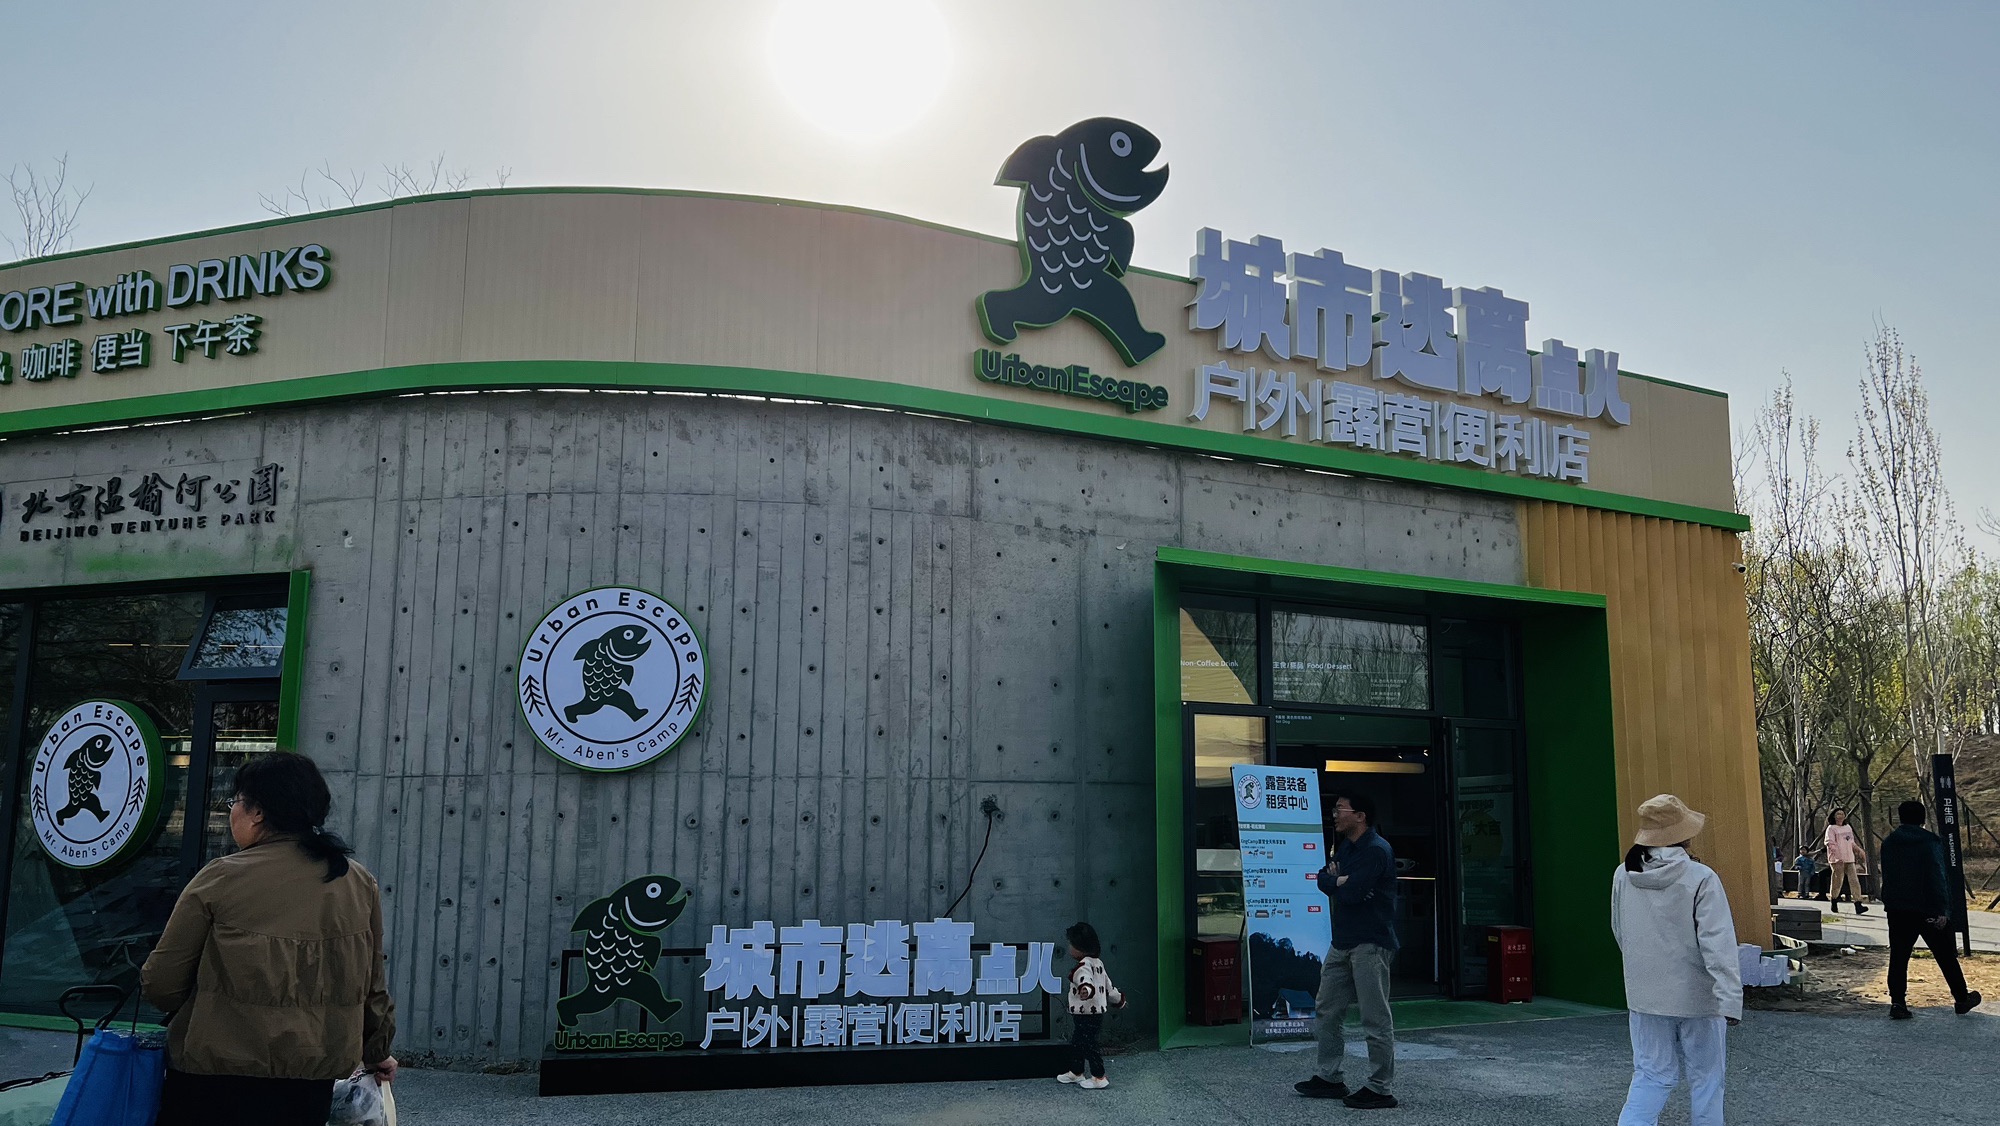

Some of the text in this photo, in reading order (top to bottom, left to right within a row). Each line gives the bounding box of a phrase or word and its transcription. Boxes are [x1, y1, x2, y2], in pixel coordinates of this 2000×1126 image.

[86, 271, 159, 318] with
[167, 244, 328, 308] DRINKS
[1185, 227, 1630, 426] 城市逃离点儿
[20, 339, 79, 381] 咖啡
[90, 329, 148, 373] 便当
[163, 314, 259, 362] 下午茶
[20, 511, 275, 542] BEIJING WENYUHE PARK
[527, 592, 698, 663] Urban Escape
[1221, 659, 1239, 667] Drink
[1307, 662, 1353, 670] Food/Dessert
[35, 705, 145, 773] Urban Escape
[544, 721, 678, 760] Mr. Aben's Camp
[1265, 775, 1307, 792] 露营装备
[1266, 794, 1309, 811] 租赁中心
[1943, 797, 1955, 825] 卫生间
[43, 822, 130, 859] Mr. Aben's Camp
[1948, 832, 1957, 867] WASHROOM
[699, 917, 1062, 1000] 城市逃离点儿
